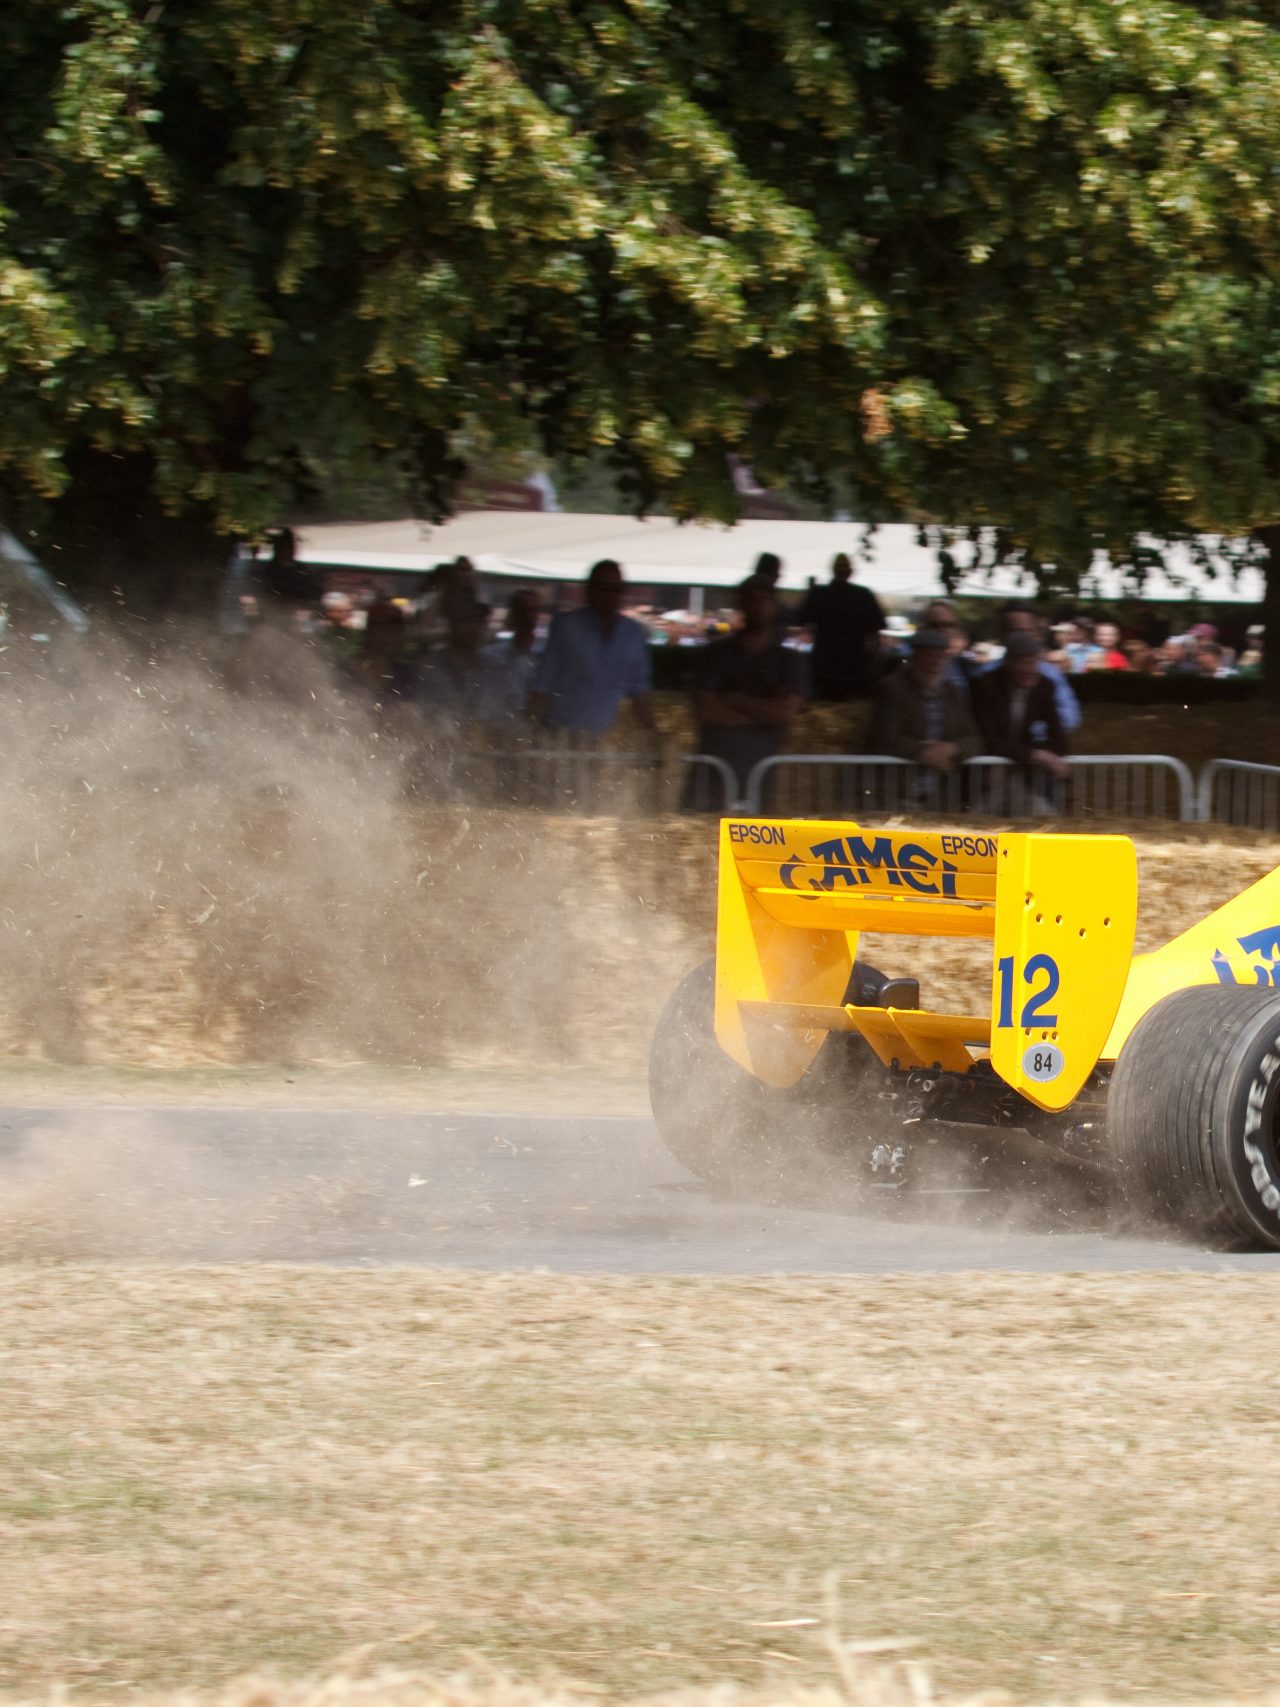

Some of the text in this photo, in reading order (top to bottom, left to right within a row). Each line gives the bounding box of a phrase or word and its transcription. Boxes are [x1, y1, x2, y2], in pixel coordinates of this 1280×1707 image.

[729, 824, 786, 845] EPSON
[941, 835, 998, 857] EPSON
[779, 836, 983, 909] CAMEL
[997, 953, 1060, 1028] 12
[1033, 1053, 1052, 1072] 84
